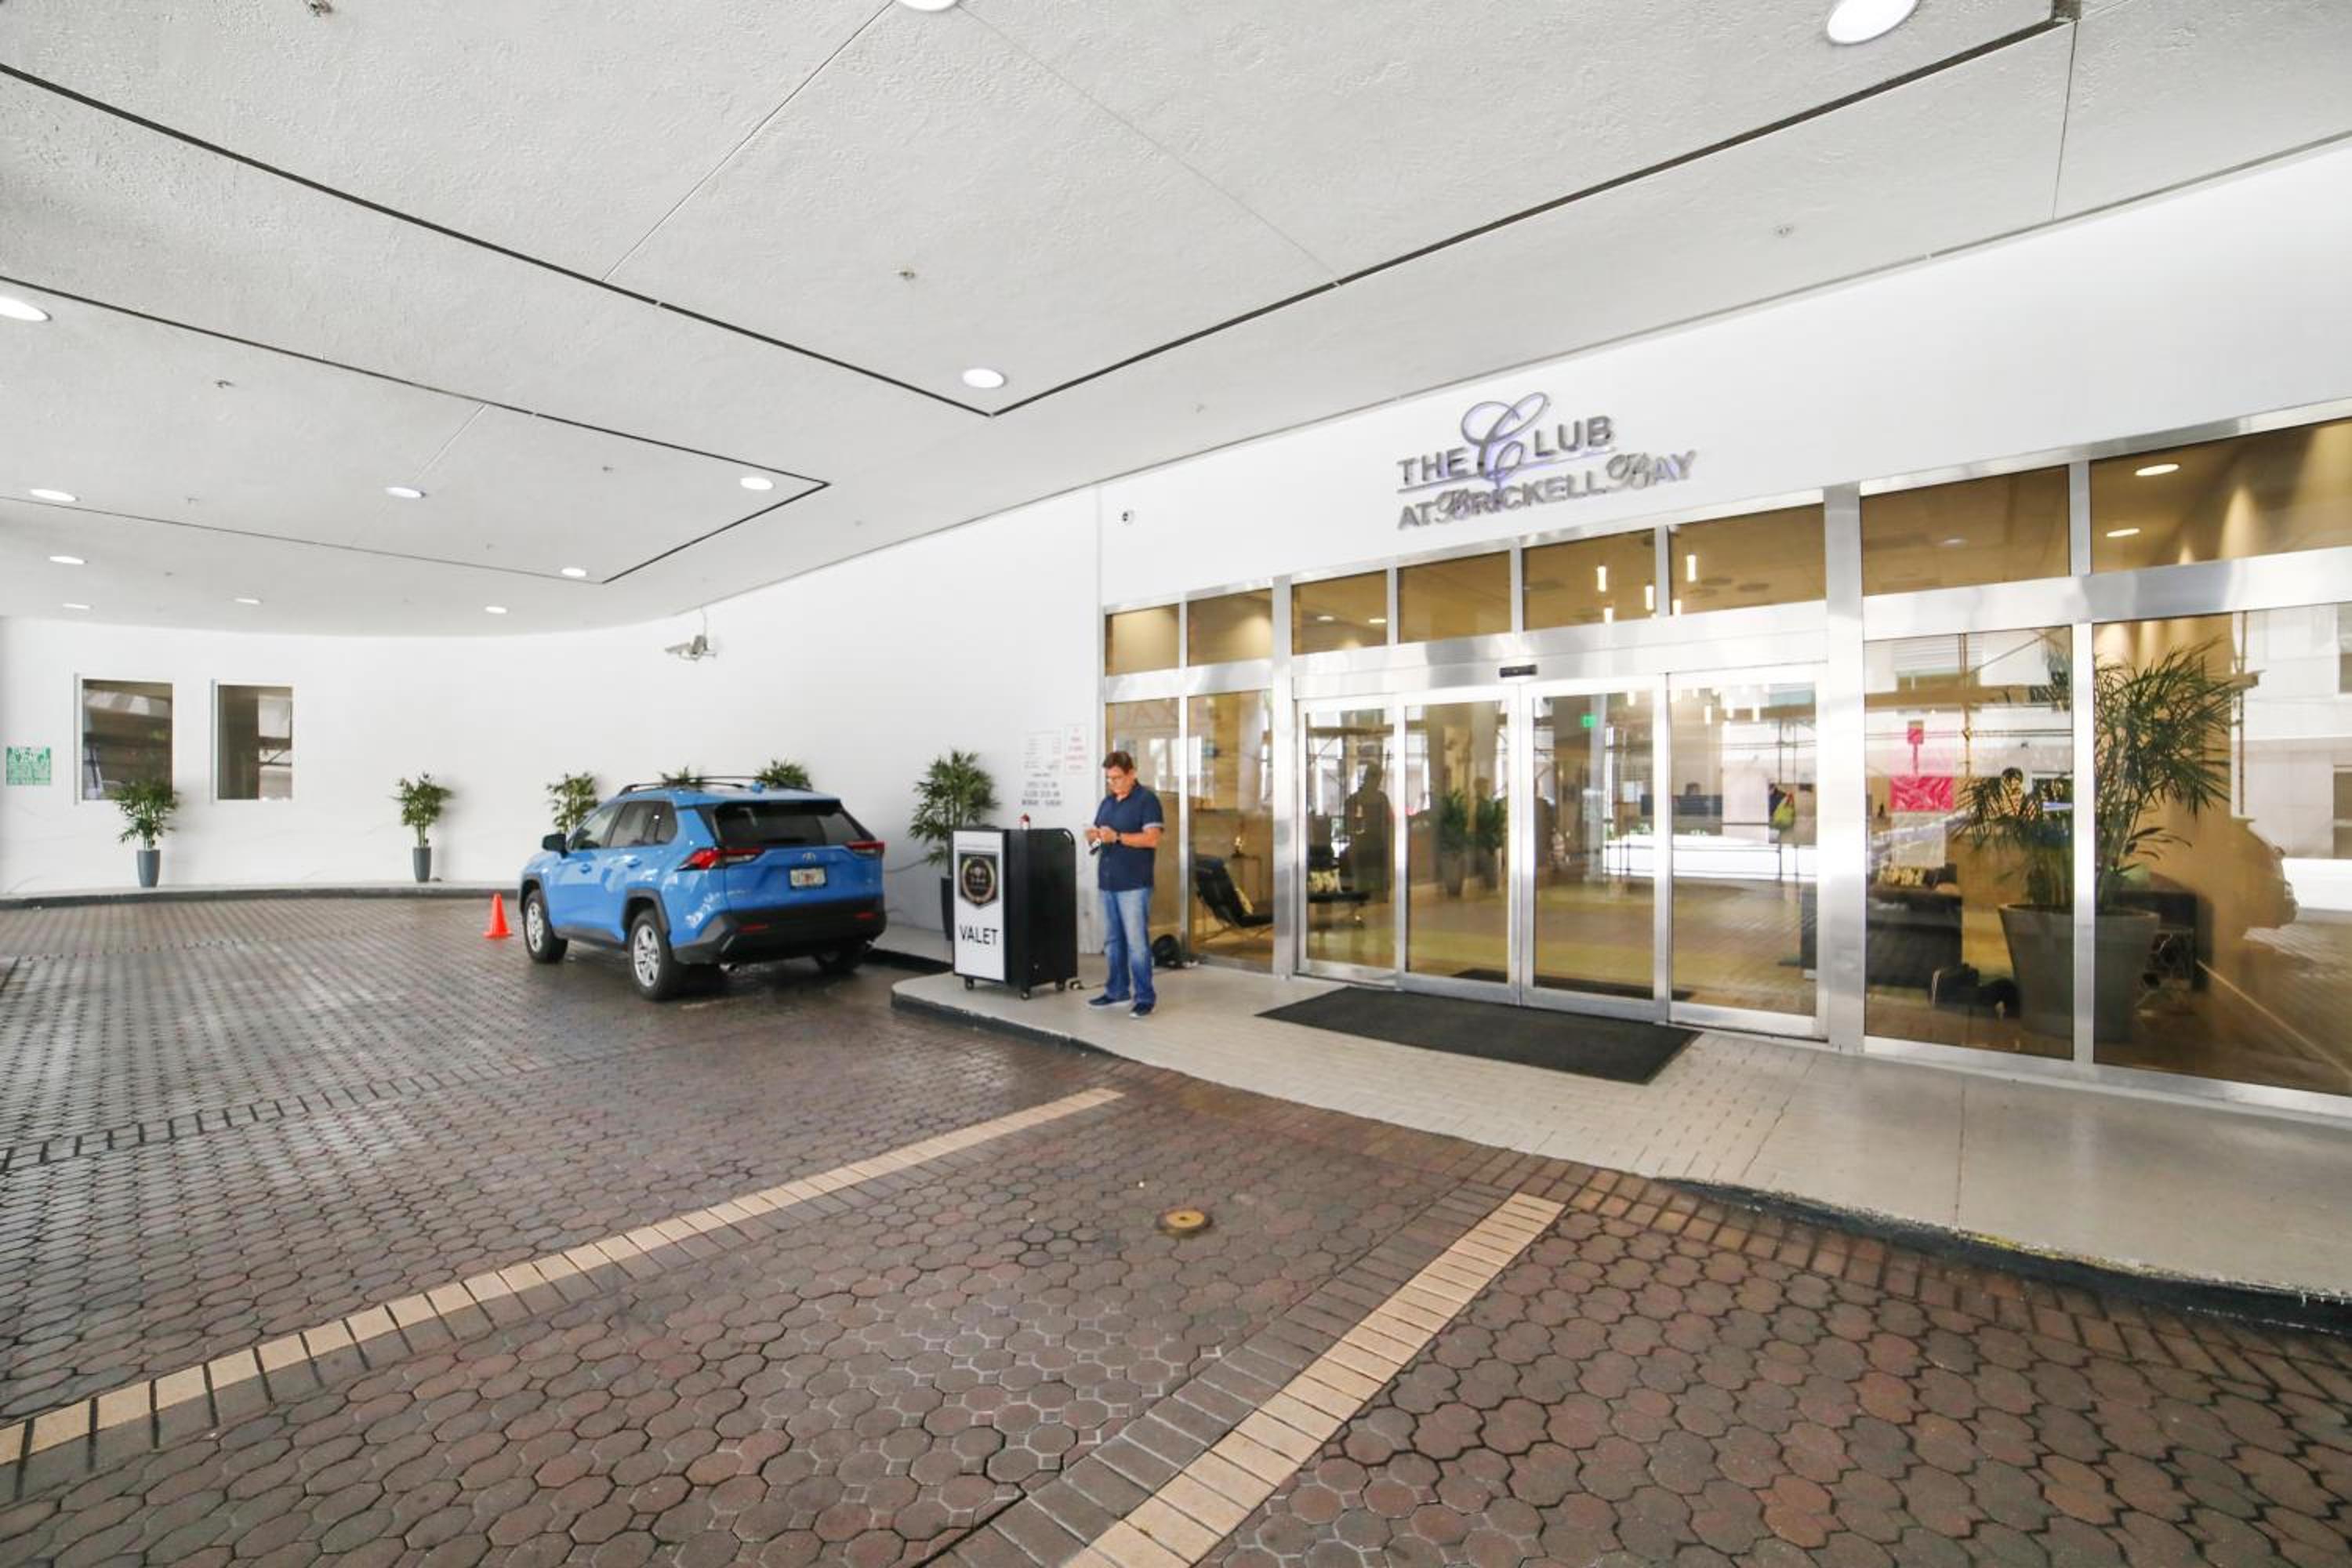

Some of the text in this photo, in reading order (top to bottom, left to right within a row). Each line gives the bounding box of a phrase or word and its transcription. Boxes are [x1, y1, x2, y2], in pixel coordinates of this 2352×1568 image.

[1396, 392, 1613, 490] THE CLUB
[1398, 450, 1697, 530] AT BRICKELL BAY
[959, 924, 998, 946] VALET
